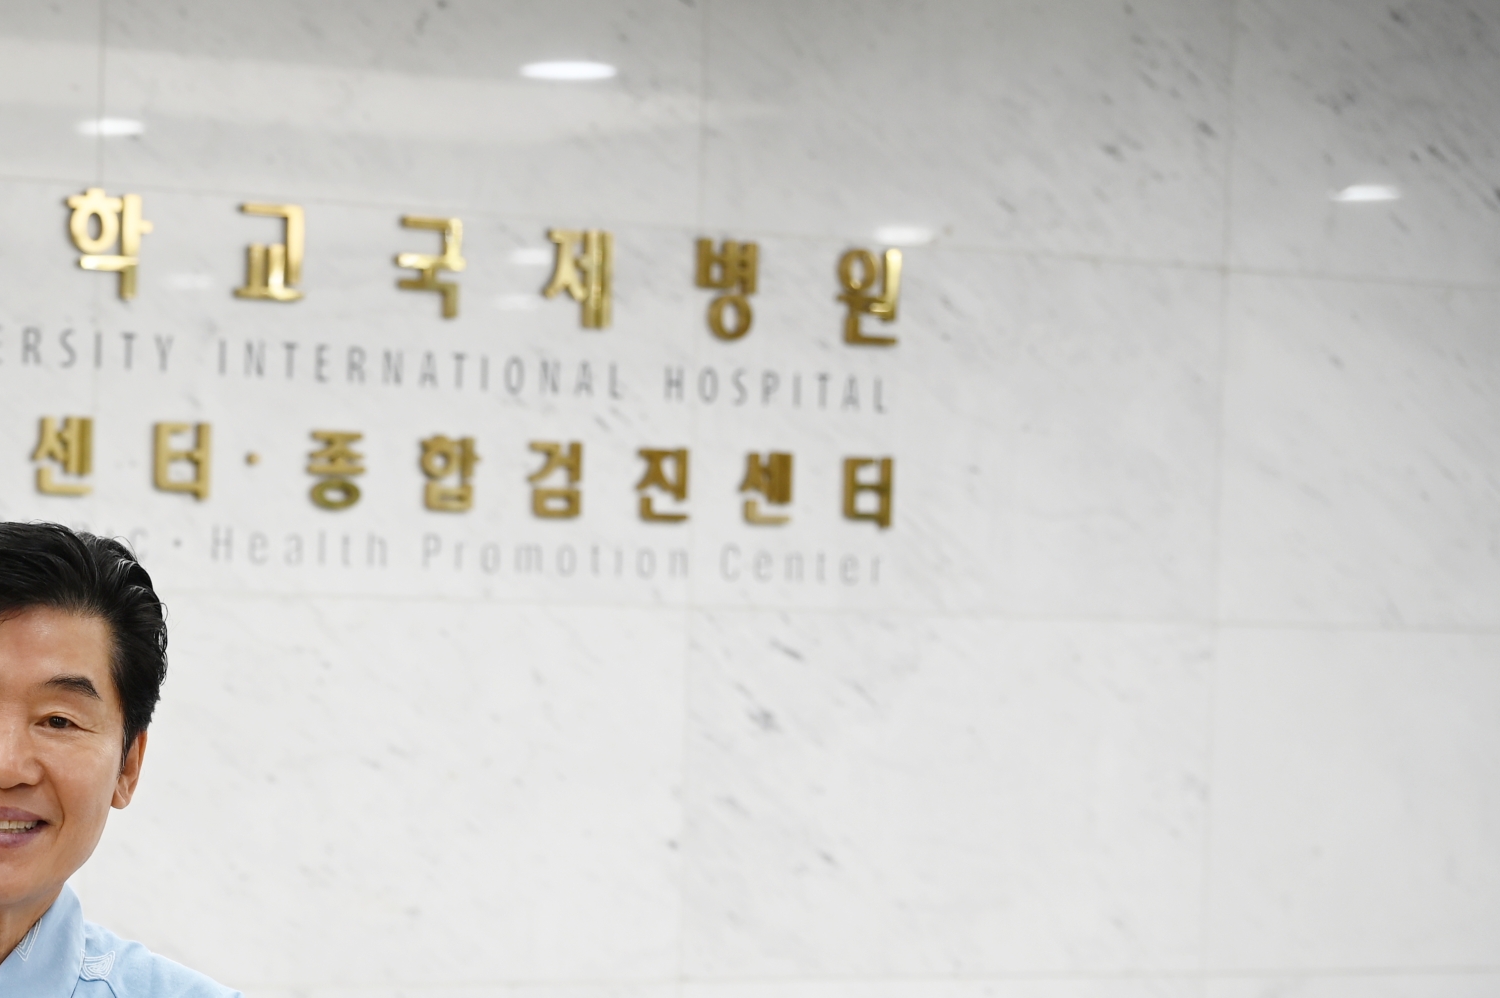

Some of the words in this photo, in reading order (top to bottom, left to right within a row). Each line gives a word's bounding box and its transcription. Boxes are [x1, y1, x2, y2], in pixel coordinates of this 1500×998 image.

[217, 336, 623, 402] INTERNATIONAL
[663, 365, 889, 414] HOSPITAL
[209, 525, 388, 568] Health
[420, 532, 690, 579] Promotion
[719, 542, 883, 585] Center
